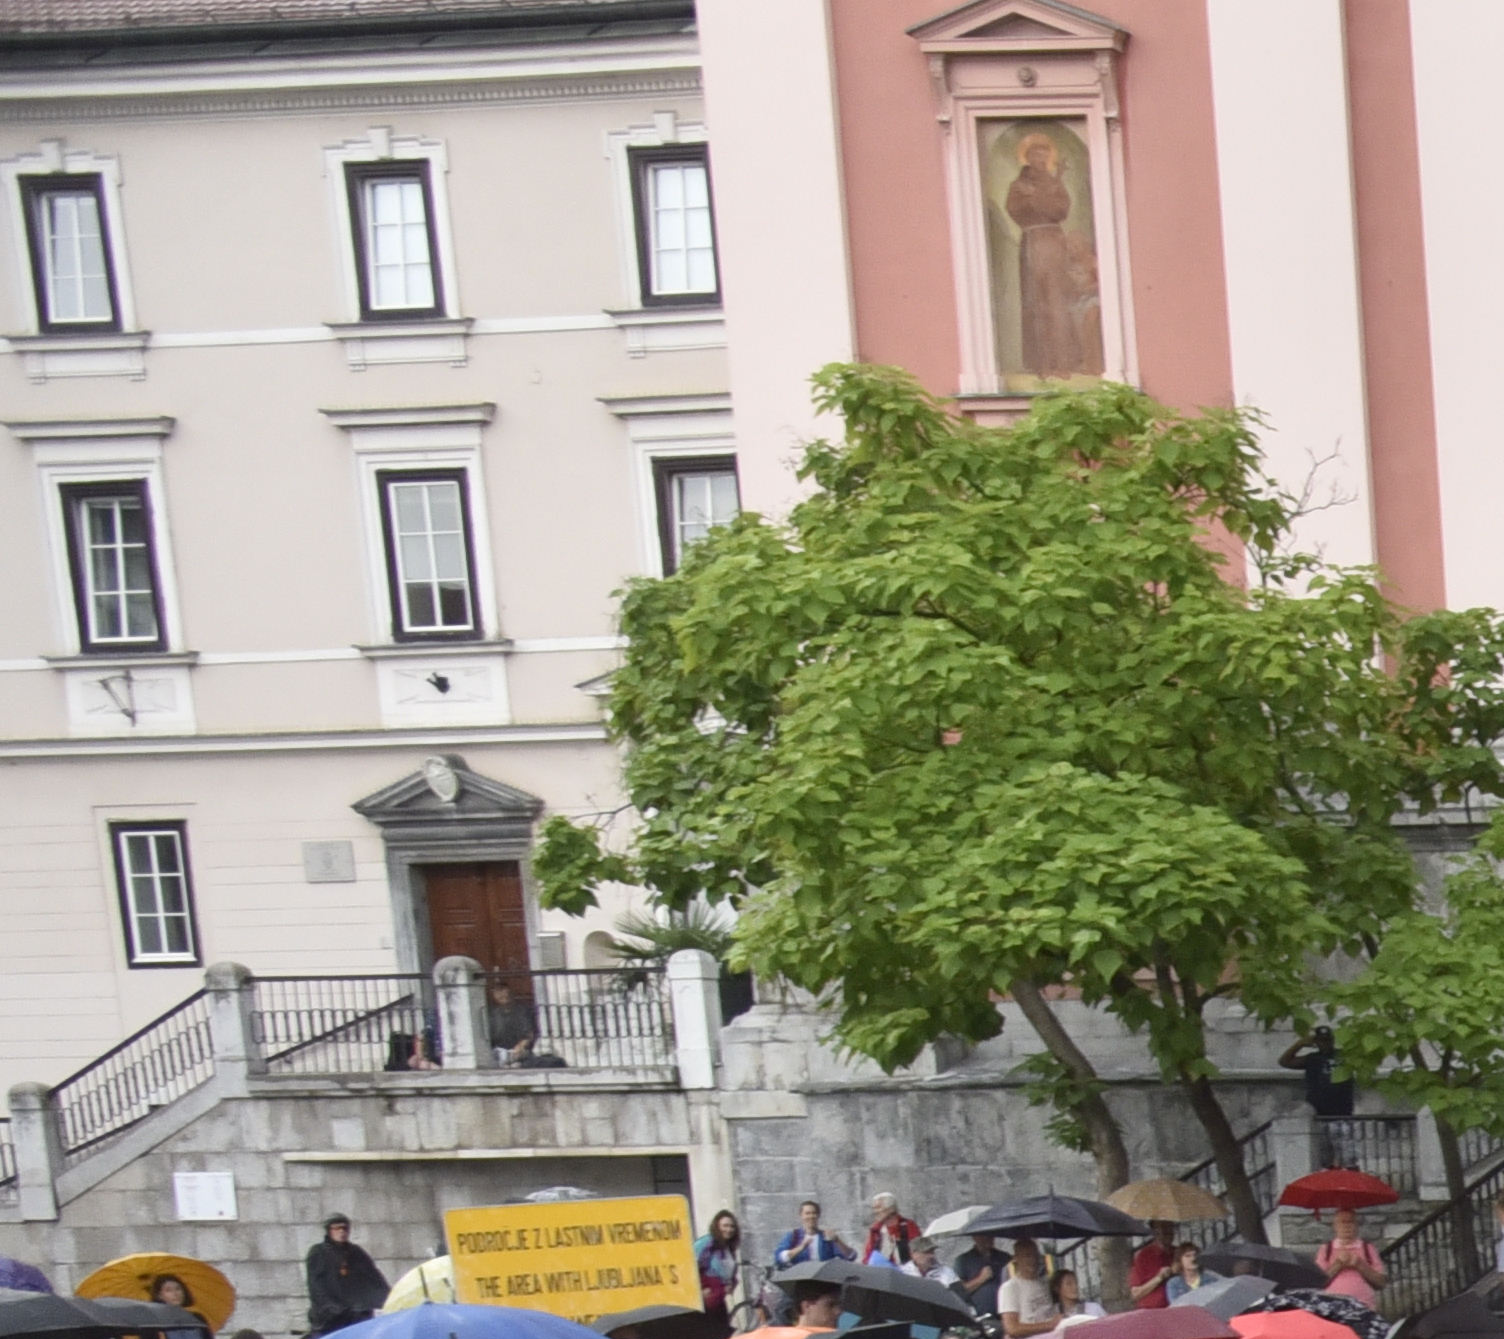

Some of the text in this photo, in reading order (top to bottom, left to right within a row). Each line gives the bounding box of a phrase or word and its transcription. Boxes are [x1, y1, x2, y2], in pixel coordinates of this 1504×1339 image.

[532, 1227, 544, 1250] Z
[545, 1224, 603, 1250] LASTNIM
[608, 1219, 682, 1246] VREMENOM
[475, 1275, 503, 1299] THE
[507, 1273, 544, 1297] AREA
[544, 1270, 583, 1295] WITH
